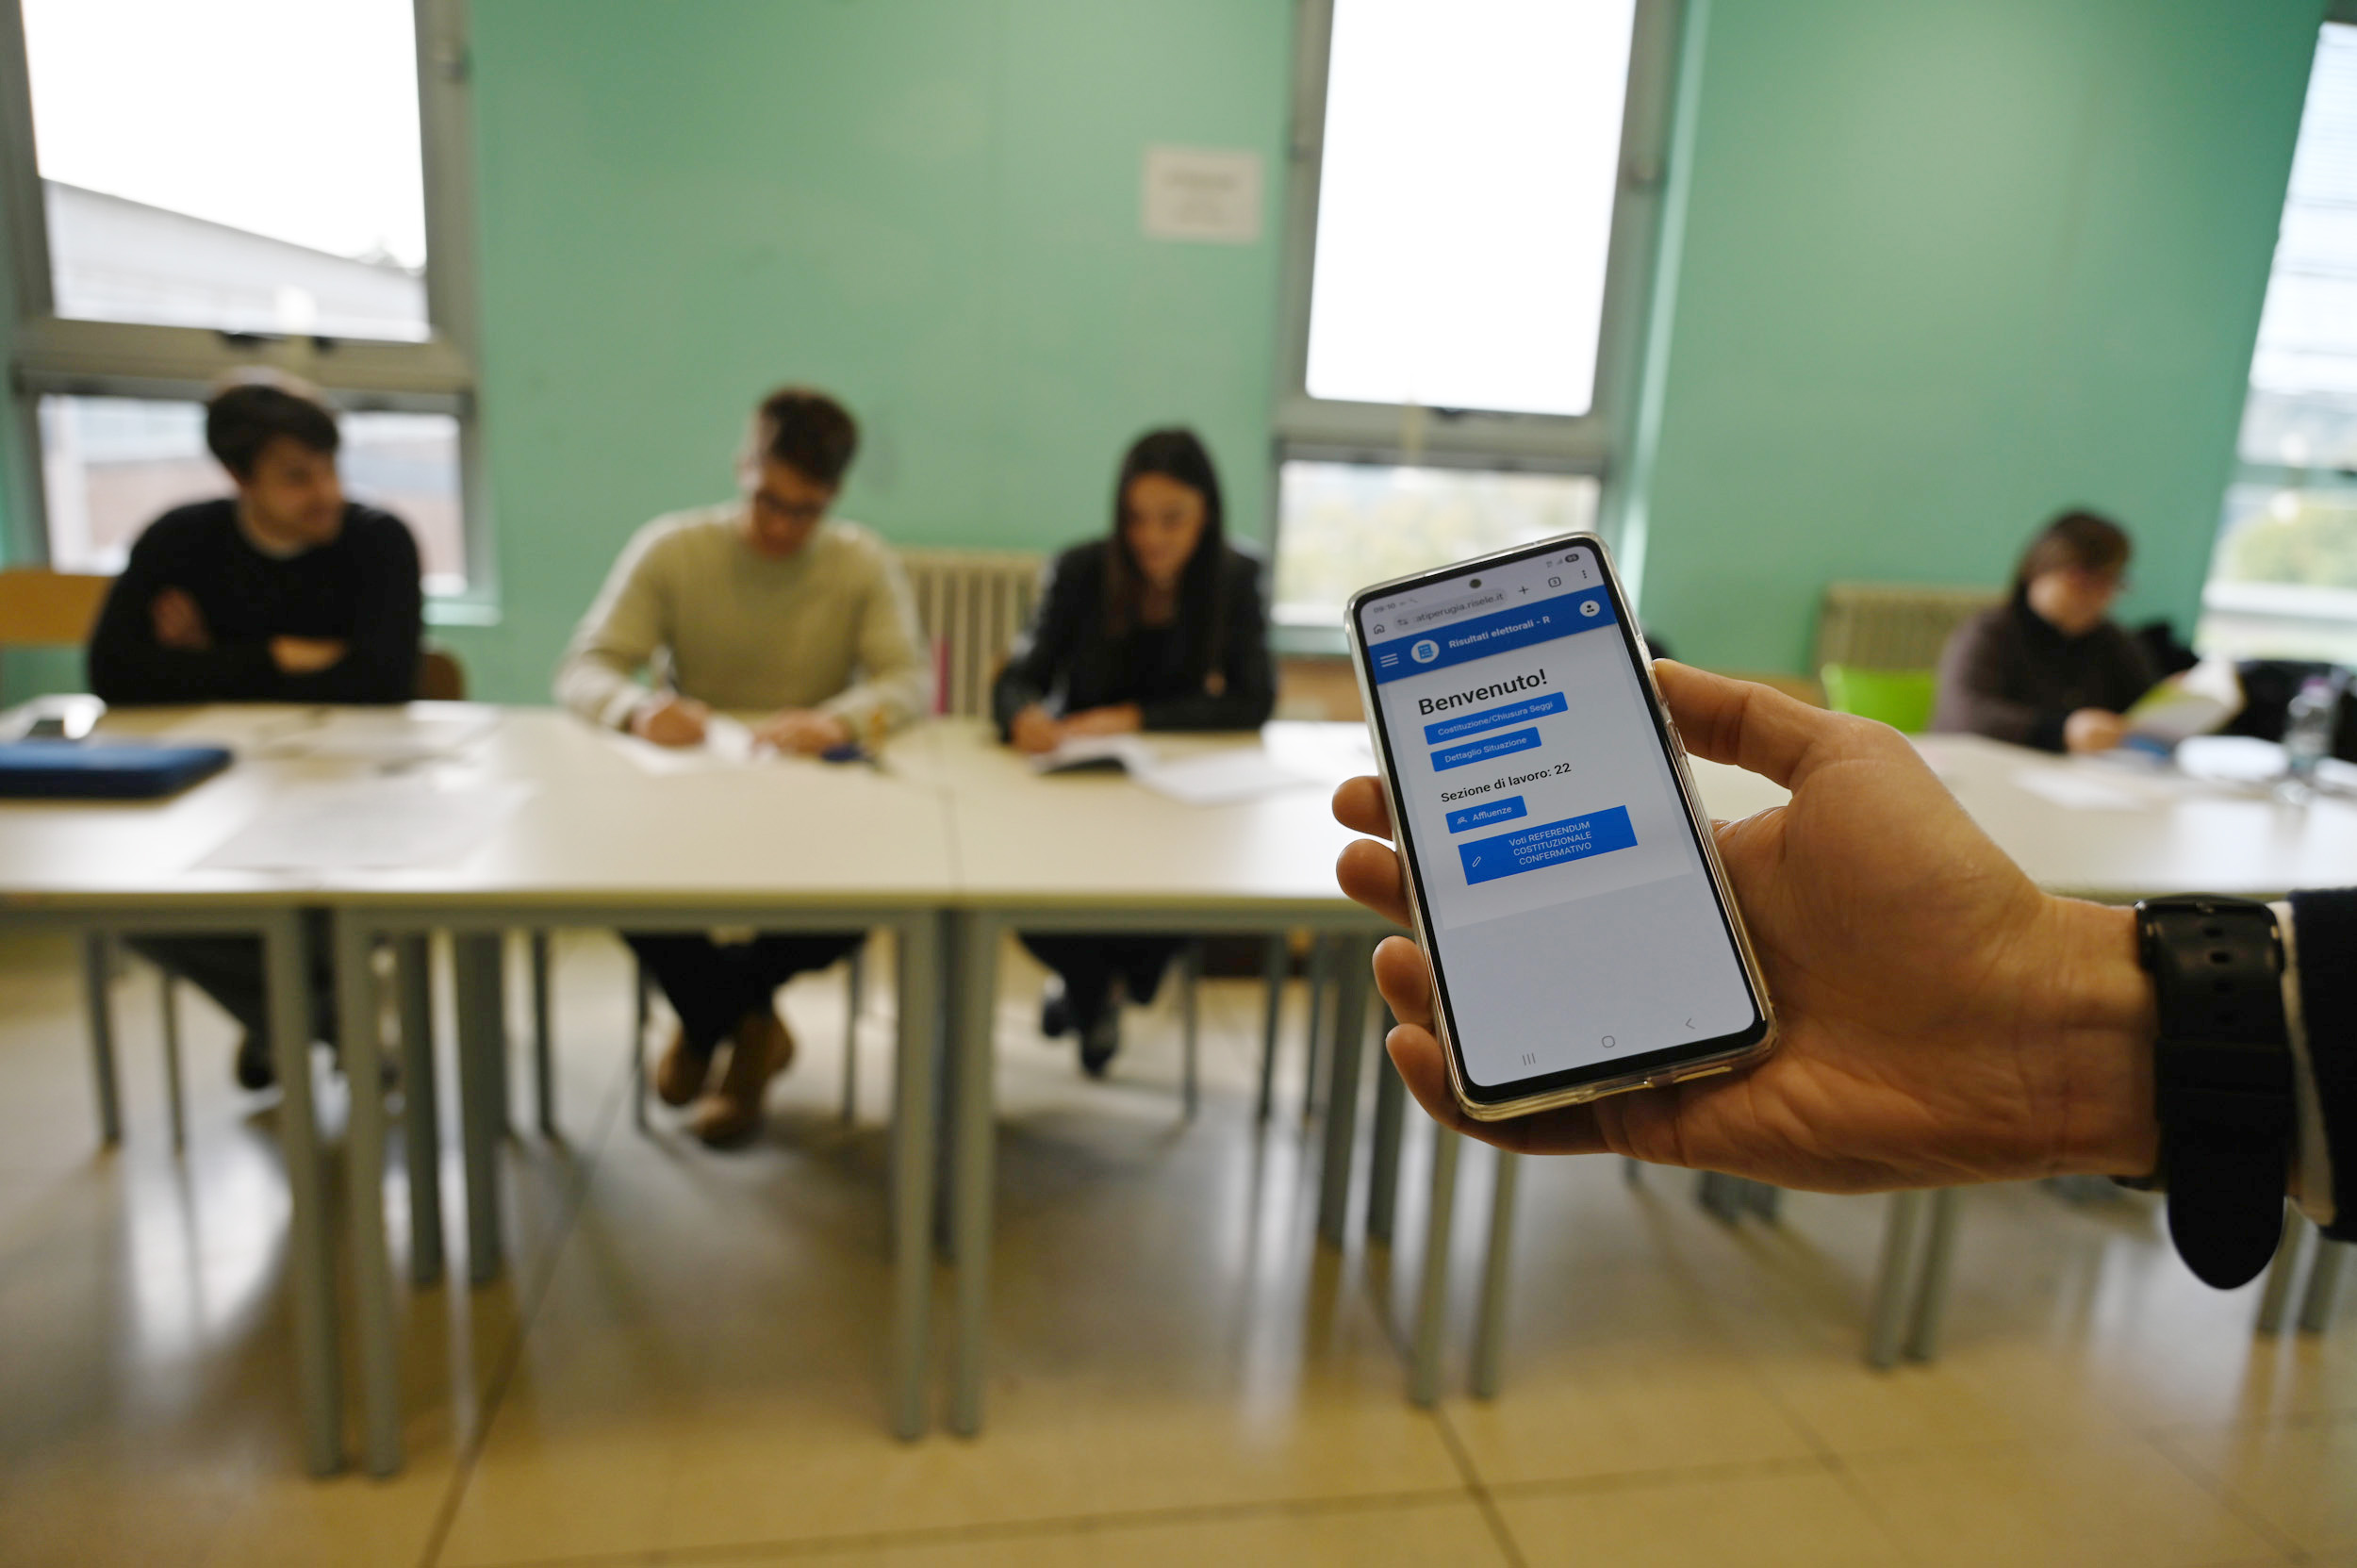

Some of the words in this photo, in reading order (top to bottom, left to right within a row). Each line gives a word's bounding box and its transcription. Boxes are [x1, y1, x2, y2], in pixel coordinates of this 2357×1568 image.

[1448, 632, 1489, 649] Risultati
[1492, 619, 1534, 638] elettorali
[1542, 616, 1551, 624] R
[1418, 668, 1548, 716] Benvenuto!
[1437, 707, 1528, 736] Costituzione/Chiusura
[1529, 701, 1554, 715] Seggi
[1444, 747, 1482, 764] Dettaglio
[1483, 735, 1527, 754] Situazione
[1441, 783, 1492, 802] Sezione
[1493, 778, 1506, 790] di
[1508, 768, 1553, 786] lavoro:
[1554, 762, 1572, 775] 22
[1472, 805, 1512, 821] Affluenze
[1508, 834, 1527, 848] Voti
[1528, 820, 1591, 842] REFERENDUM
[1513, 831, 1592, 857] COSTITUZIONALE
[1519, 841, 1592, 866] CONFERMATIVO
